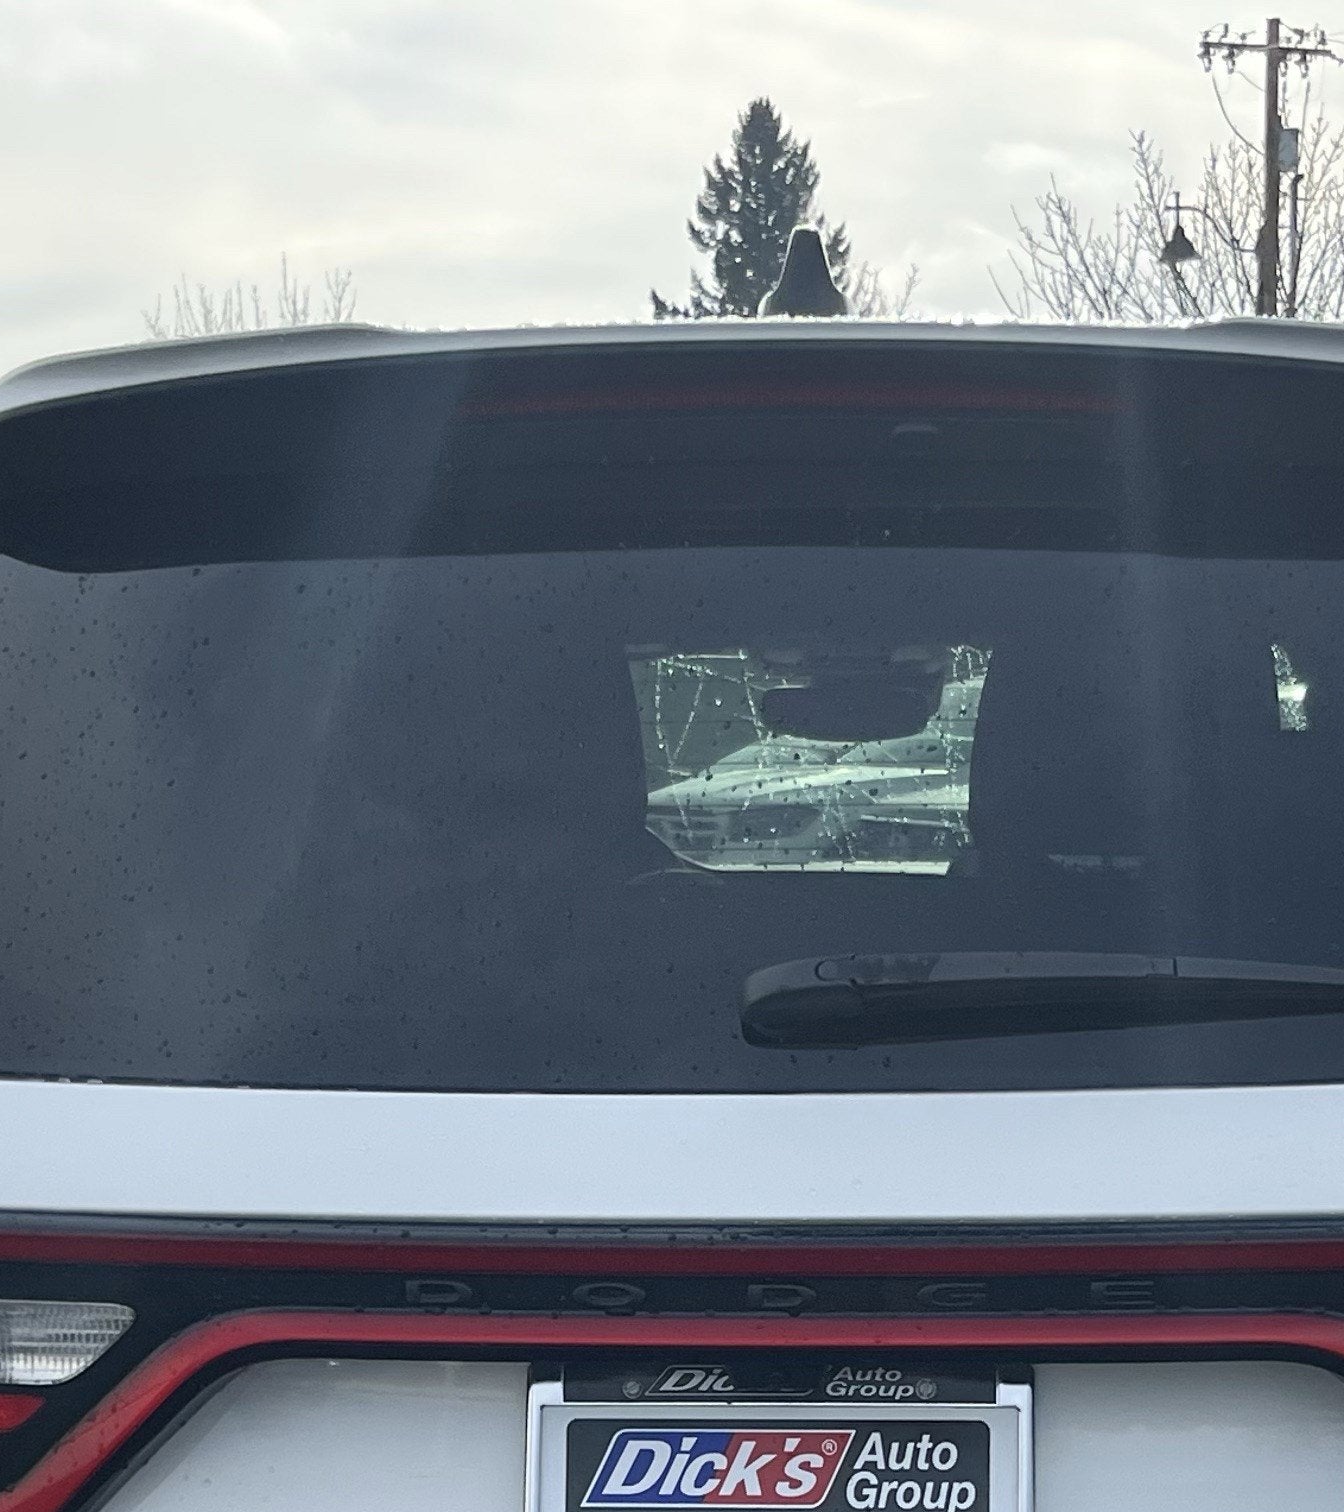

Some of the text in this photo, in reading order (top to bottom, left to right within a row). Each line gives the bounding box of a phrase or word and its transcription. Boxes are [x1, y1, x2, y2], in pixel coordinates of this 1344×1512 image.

[404, 1279, 1155, 1307] DODGE
[833, 1367, 903, 1383] Auto
[825, 1381, 916, 1400] Group
[855, 1432, 959, 1471] Auto
[601, 1437, 825, 1497] Dick's
